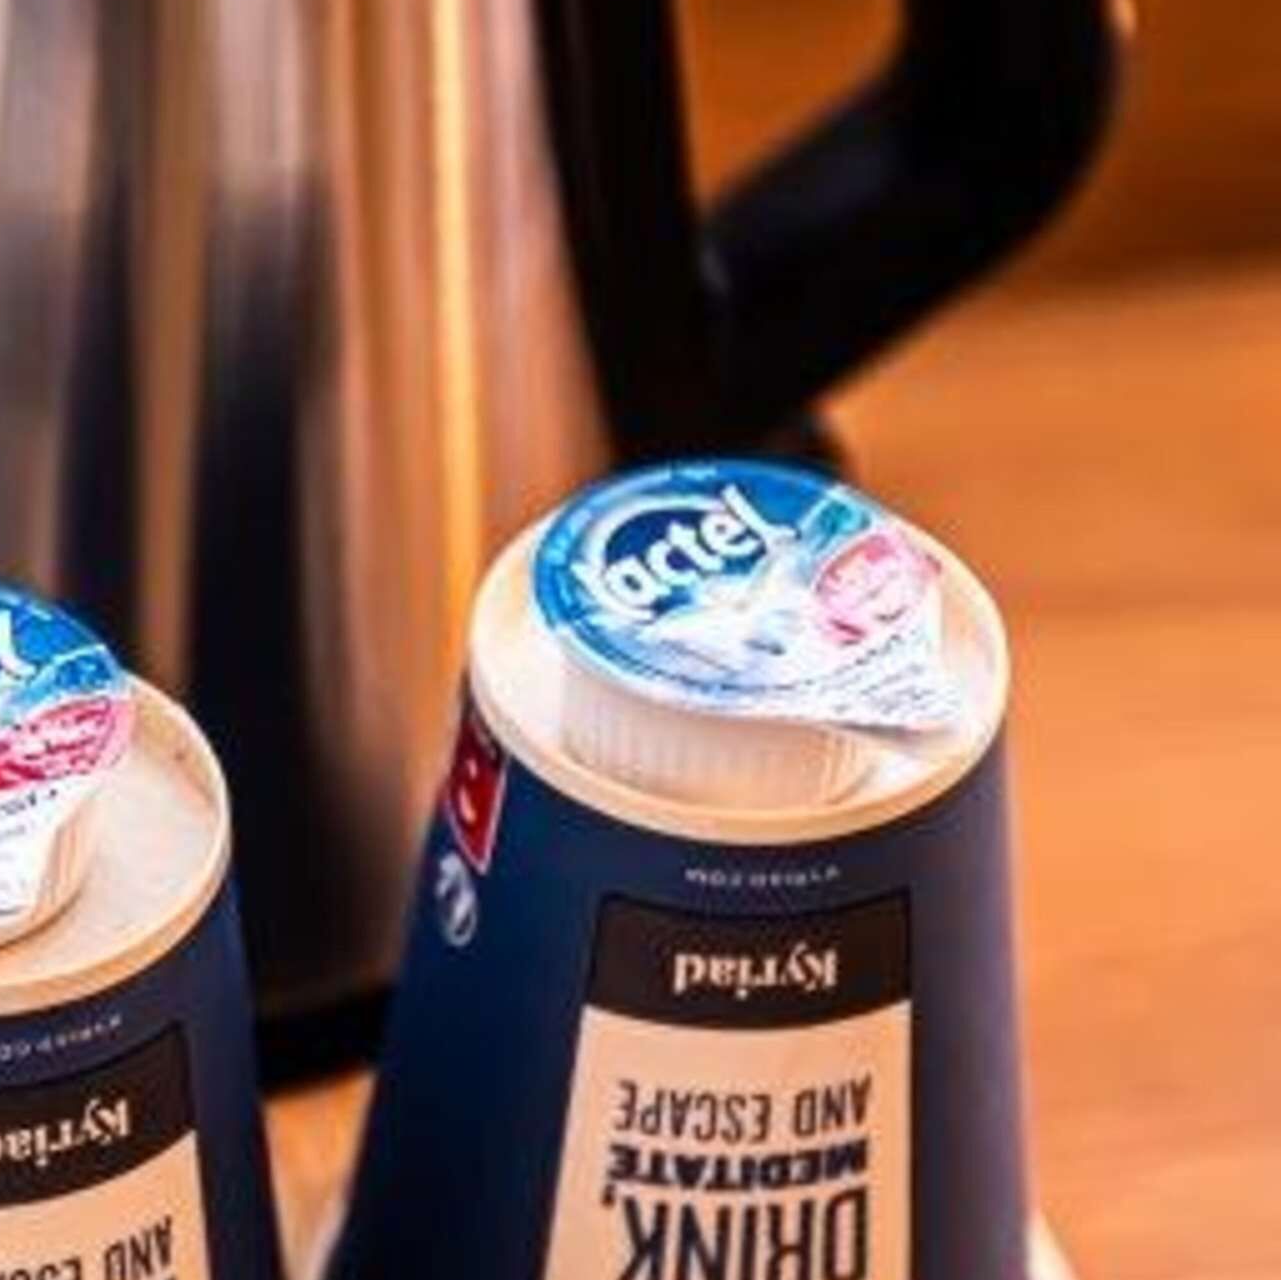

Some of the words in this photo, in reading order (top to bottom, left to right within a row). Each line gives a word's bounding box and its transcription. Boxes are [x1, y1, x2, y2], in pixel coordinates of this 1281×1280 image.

[568, 483, 801, 620] lactel
[672, 942, 839, 1000] Kyriad
[614, 1078, 773, 1144] ESCAPE
[793, 1074, 873, 1136] AND
[608, 1137, 869, 1193] MEDITATE
